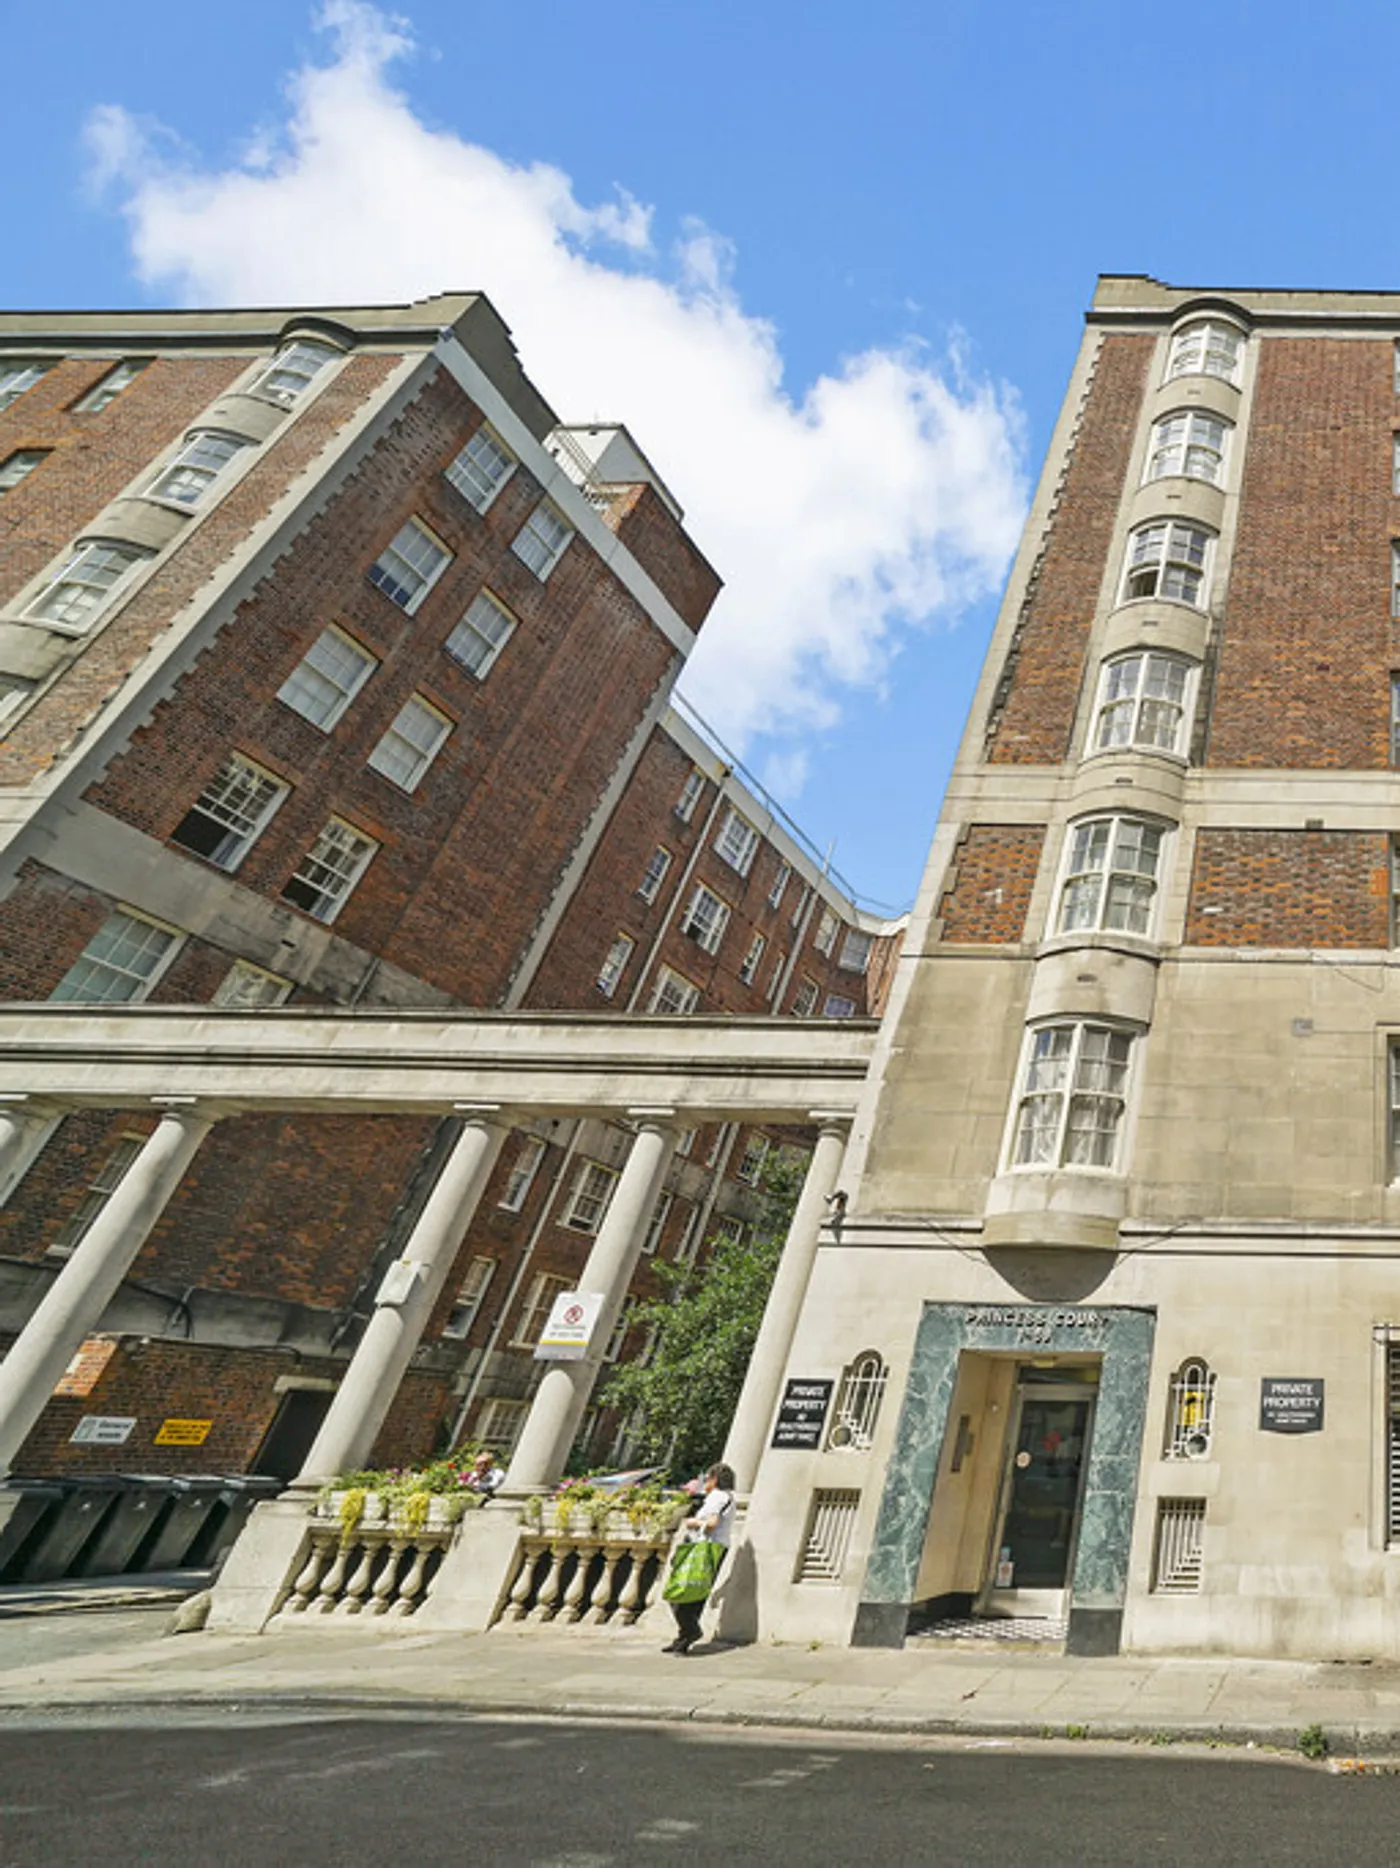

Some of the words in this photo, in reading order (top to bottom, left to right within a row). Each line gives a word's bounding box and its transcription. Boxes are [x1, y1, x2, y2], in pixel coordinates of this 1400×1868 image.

[966, 1307, 1046, 1327] PRINCESS
[1055, 1309, 1109, 1328] COURT
[790, 1385, 829, 1397] PRIVATE
[1271, 1383, 1314, 1396] PRIVATE
[782, 1400, 827, 1411] PROPERTY
[1263, 1396, 1321, 1409] PROPERTY
